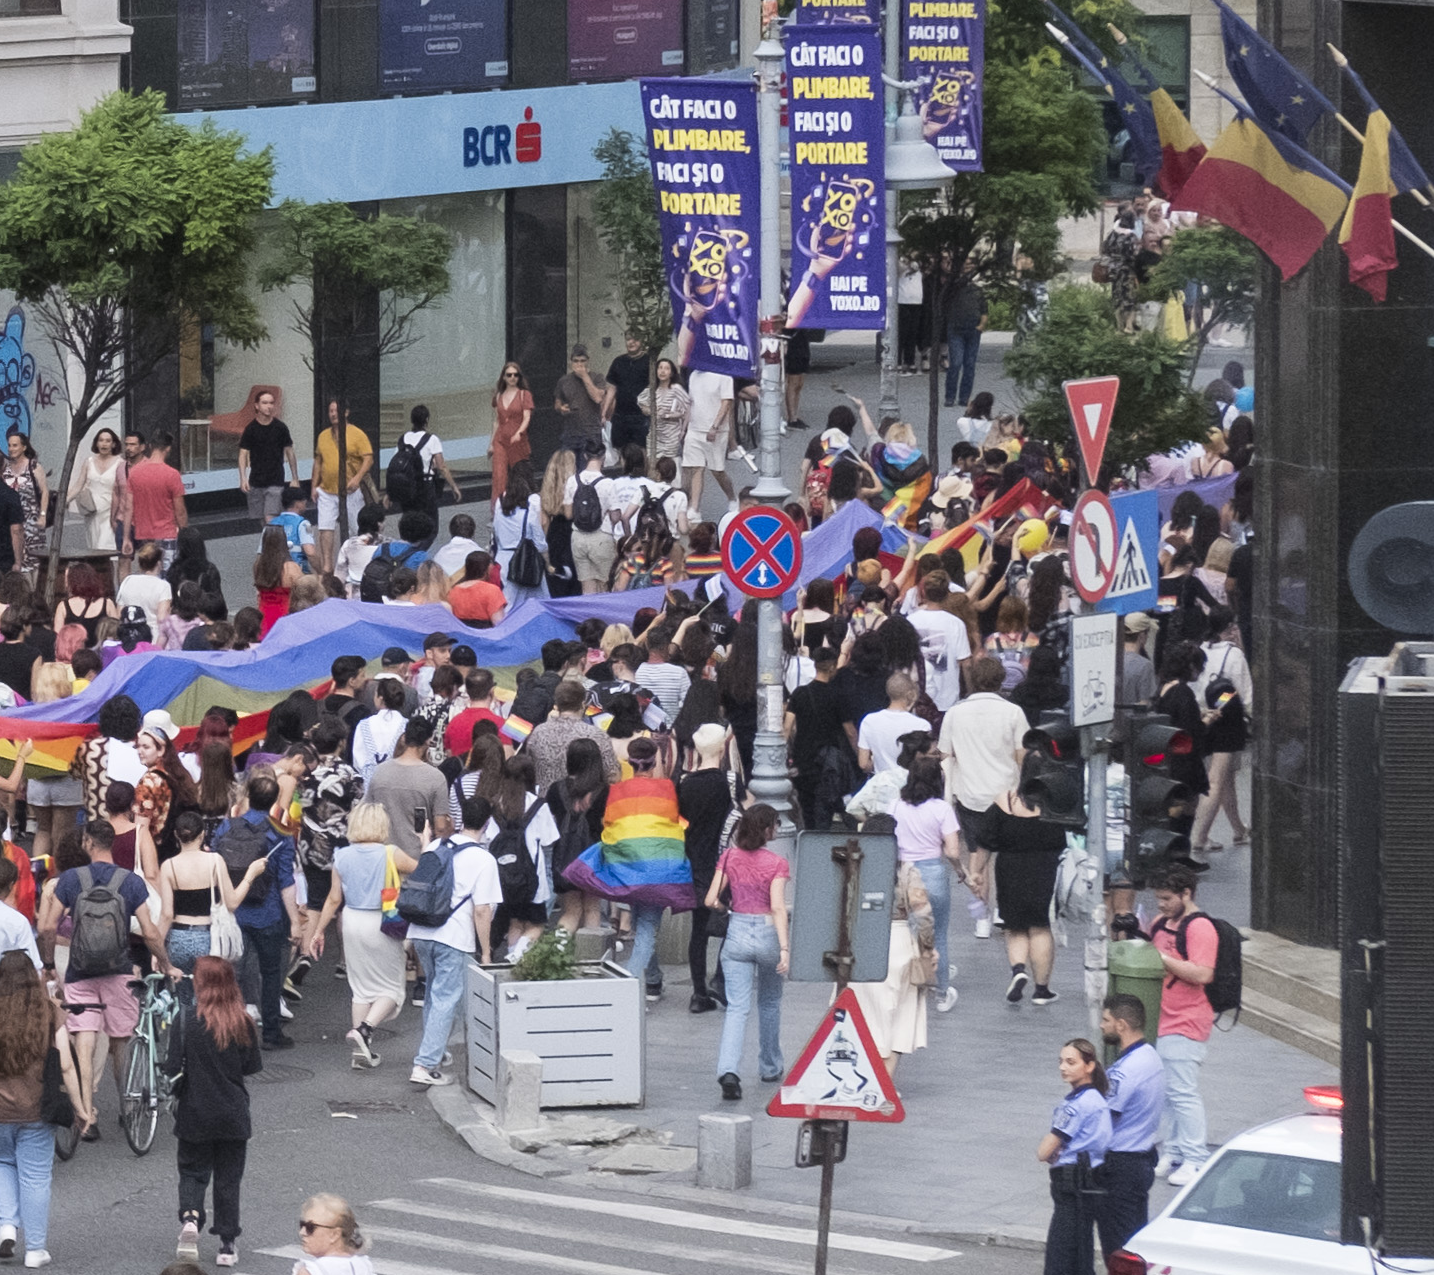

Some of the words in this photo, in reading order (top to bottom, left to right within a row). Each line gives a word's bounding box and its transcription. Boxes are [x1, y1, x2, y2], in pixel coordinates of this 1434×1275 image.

[819, 46, 853, 66] FACI
[852, 45, 863, 65] O
[793, 77, 874, 100] PLIMBARE,
[795, 112, 824, 131] FACI
[841, 112, 852, 131] O
[463, 124, 511, 168] BCR
[796, 142, 867, 164] PORTARE
[831, 276, 852, 291] HAI
[852, 276, 867, 291] PE
[830, 296, 880, 311] YOXO.RO
